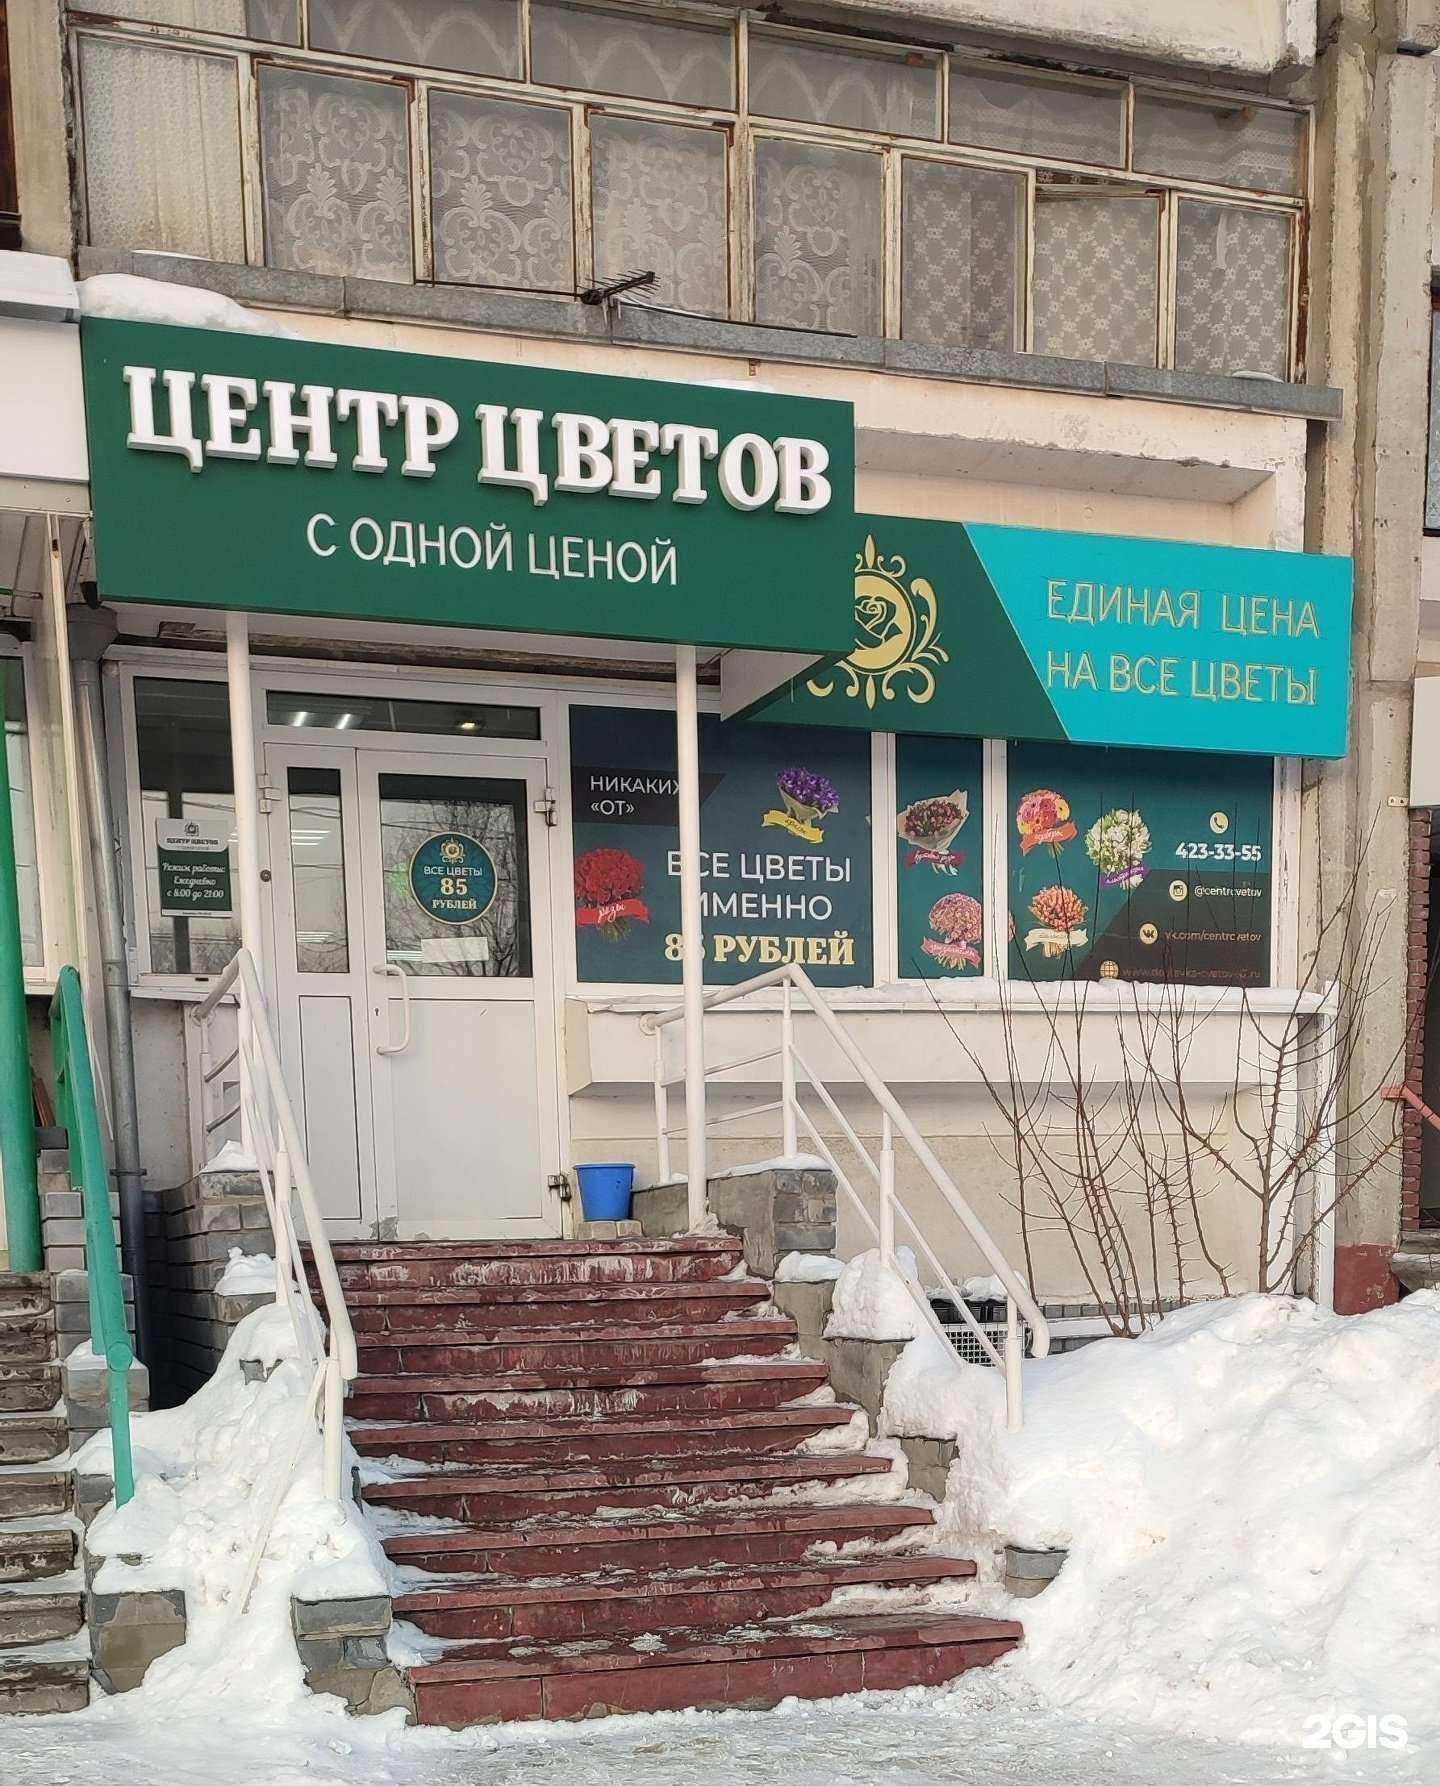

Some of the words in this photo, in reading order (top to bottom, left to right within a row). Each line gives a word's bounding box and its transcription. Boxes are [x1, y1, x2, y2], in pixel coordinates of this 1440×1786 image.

[122, 365, 460, 478] ЦЕНТР
[474, 403, 833, 516] ЦВЕТОВ
[306, 512, 337, 558] С
[348, 516, 514, 572] ОДНОЙ
[527, 532, 678, 586] ЦЕНОЙ
[1047, 579, 1200, 630] ЕДИНАЯ
[1221, 593, 1320, 639] ЦЕНА
[1047, 650, 1099, 691] НА
[1109, 654, 1179, 696] ВСЕ
[1190, 659, 1317, 705] ЦВЕТЫ
[590, 799, 635, 816] «ОТ»
[1175, 842, 1262, 861] 423-33-55
[423, 866, 444, 875] ВСЕ
[446, 866, 482, 877] ЦВЕТЫ
[740, 853, 851, 884] ЦВЕТЫ
[440, 878, 468, 895] 85
[431, 899, 477, 909] РУБЛЕЙ
[713, 930, 855, 965] РУБЛЕЙ
